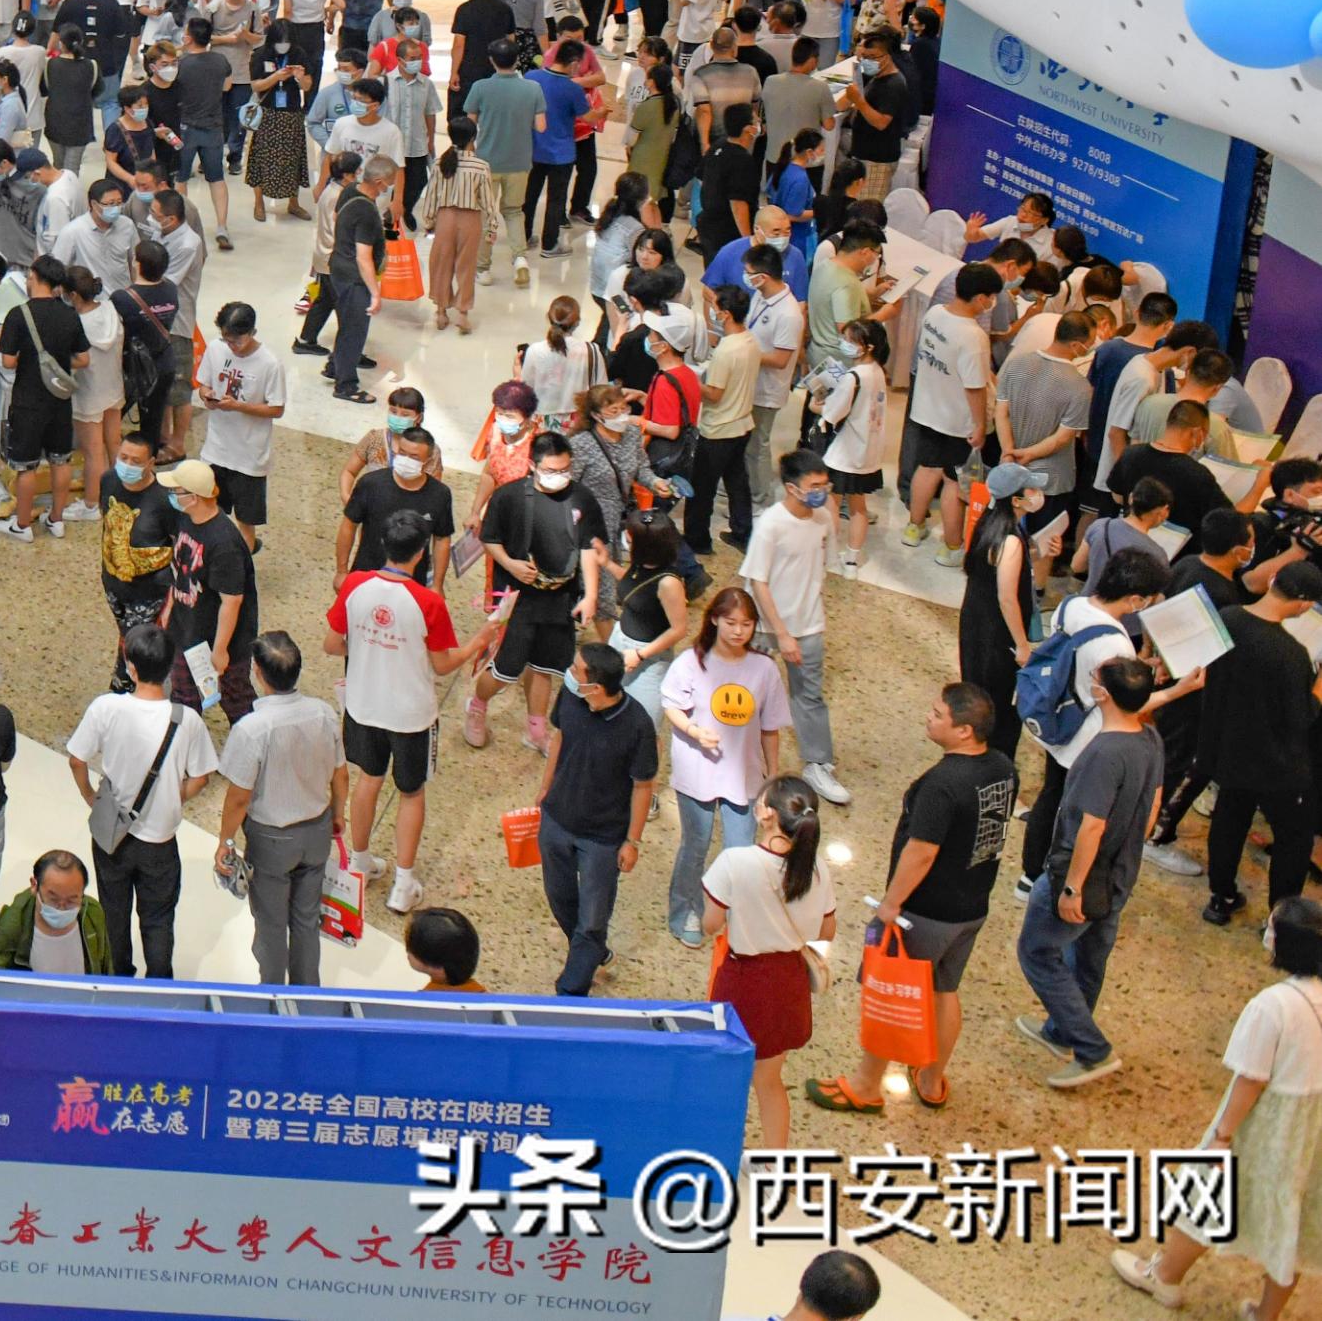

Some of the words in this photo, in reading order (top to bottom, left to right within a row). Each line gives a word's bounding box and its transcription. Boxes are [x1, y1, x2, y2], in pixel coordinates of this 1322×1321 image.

[1039, 84, 1098, 118] NORTHWEST
[1100, 110, 1166, 146] UNIVERSITY
[1015, 132, 1068, 164] 中外合作办学
[720, 710, 748, 721] drew
[50, 1076, 111, 1137] 赢
[110, 1105, 192, 1136] 在志愿
[226, 1088, 552, 1128] 2022年全国高校在陕招生
[27, 1261, 48, 1276] OF
[286, 1276, 394, 1298] CHANGCHUN
[399, 1284, 496, 1305] UNIVERSITY
[504, 1291, 527, 1307] OF
[535, 1293, 653, 1315] TECHNOLOGY
